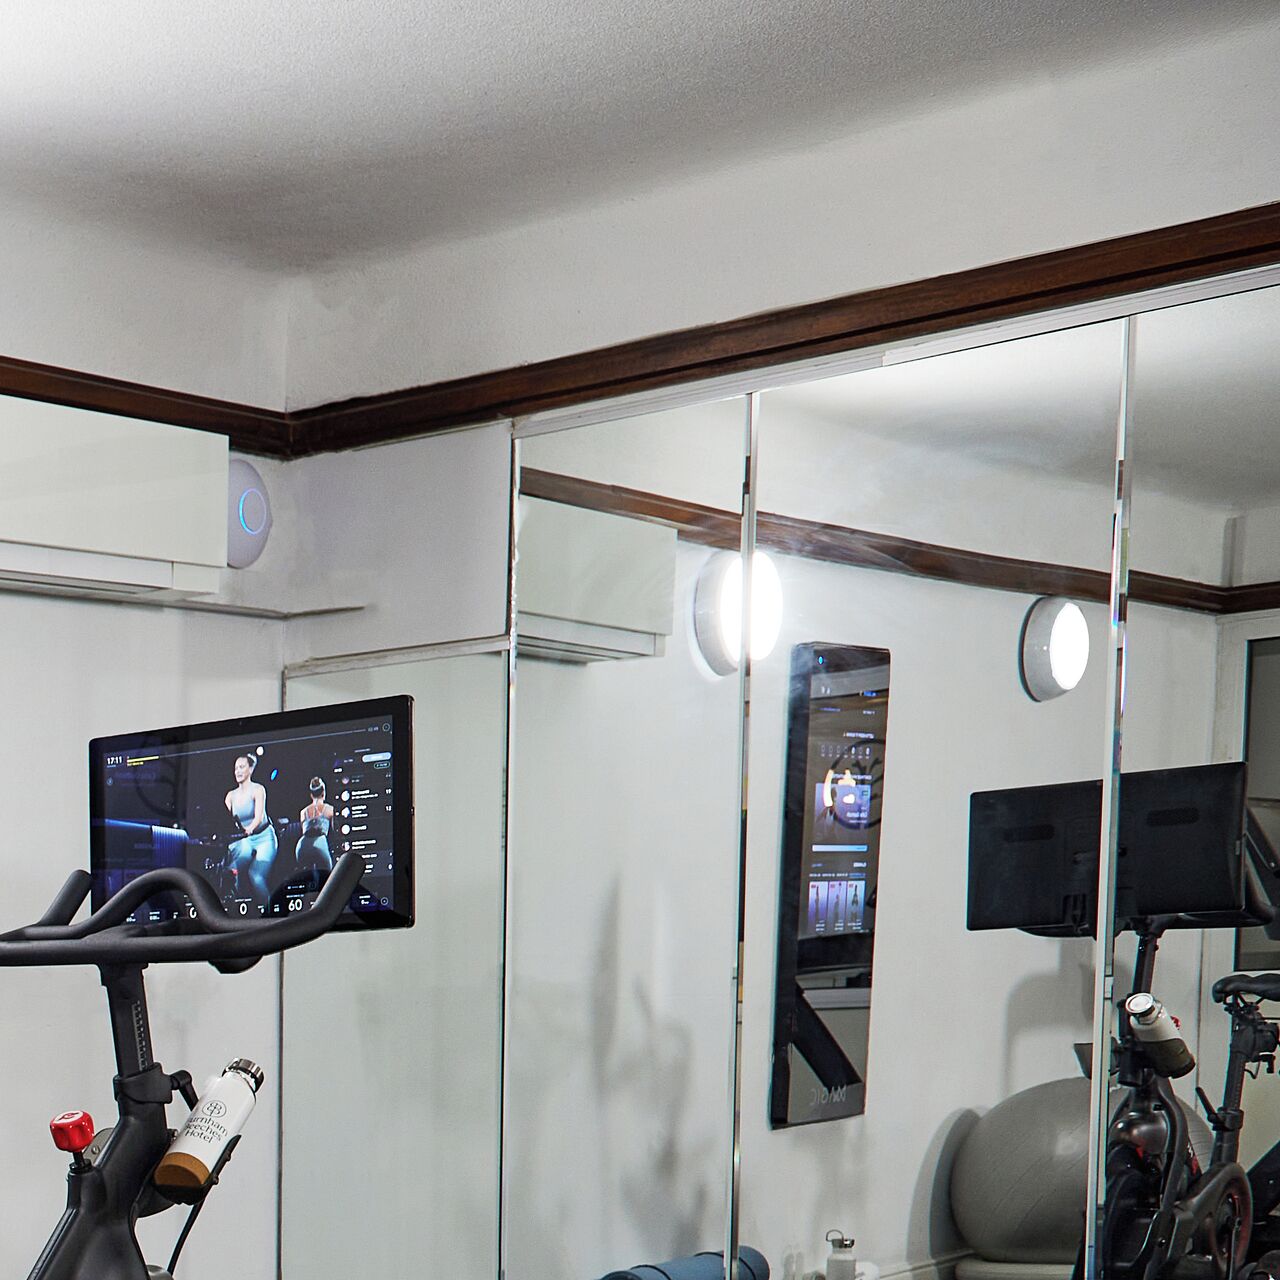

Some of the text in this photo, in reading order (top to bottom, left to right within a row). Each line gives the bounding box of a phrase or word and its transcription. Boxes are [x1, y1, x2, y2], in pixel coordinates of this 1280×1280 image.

[239, 903, 248, 915] 0
[288, 899, 303, 911] 60
[185, 1130, 213, 1143] Hotel
